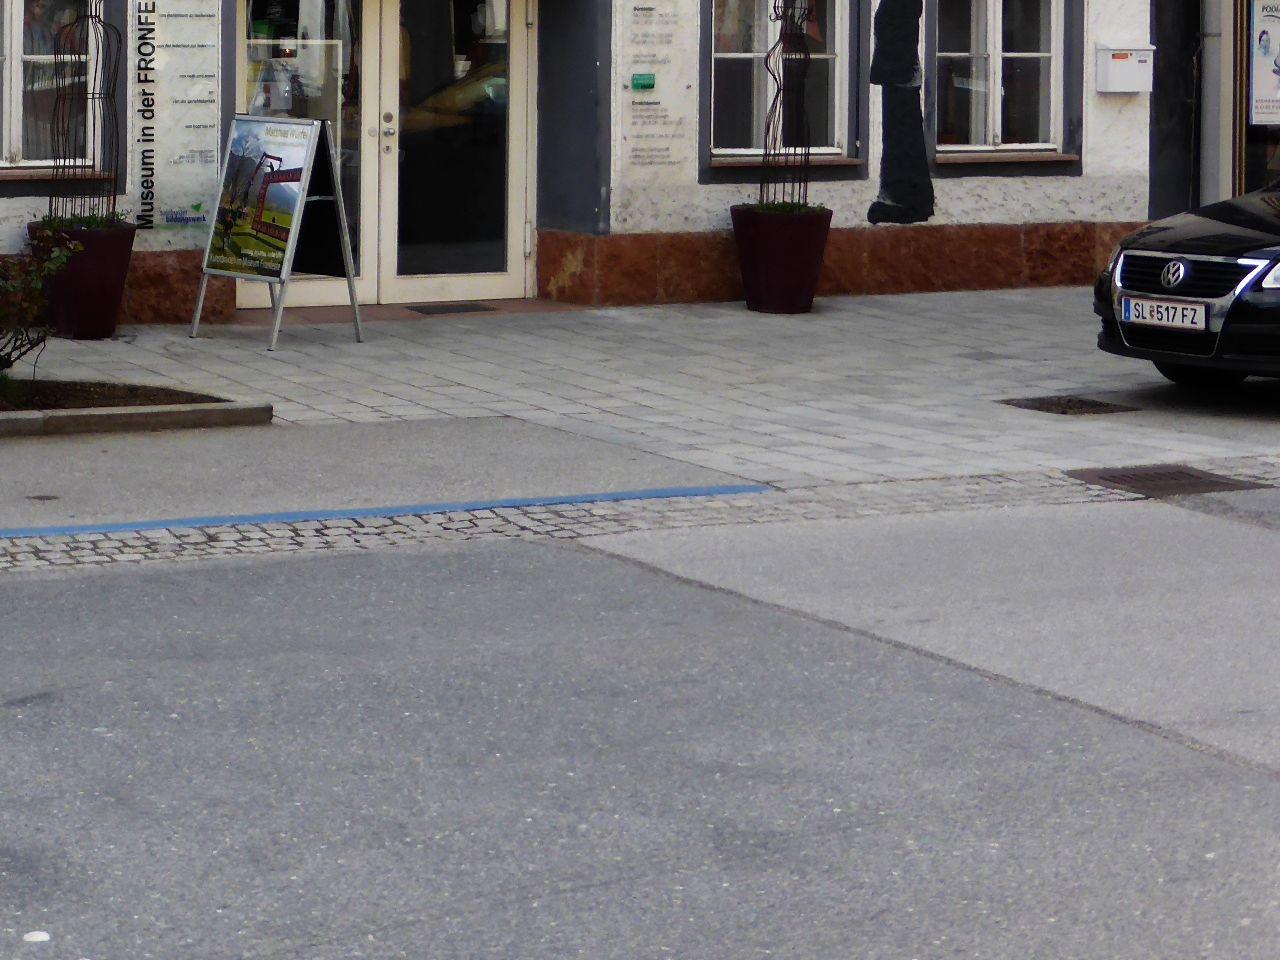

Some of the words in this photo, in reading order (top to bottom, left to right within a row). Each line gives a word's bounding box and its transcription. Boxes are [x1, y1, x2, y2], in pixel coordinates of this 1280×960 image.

[136, 88, 156, 121] der
[136, 125, 155, 144] in
[136, 148, 155, 230] Museum
[1134, 302, 1147, 320] SL
[1156, 304, 1178, 323] 517
[1181, 307, 1198, 326] FZ
